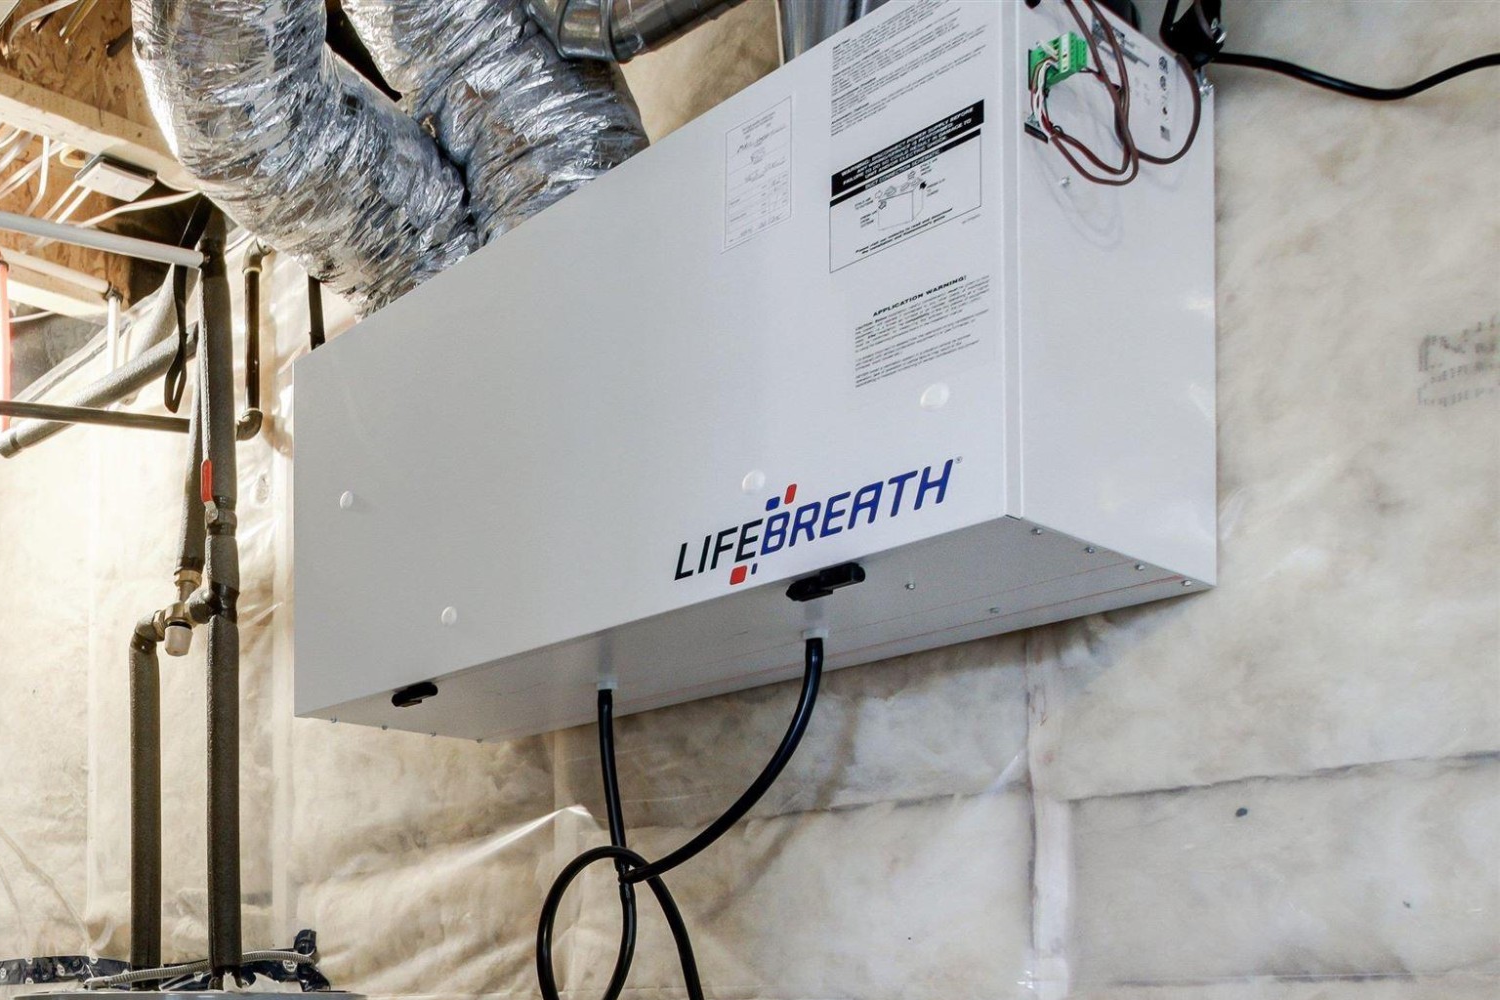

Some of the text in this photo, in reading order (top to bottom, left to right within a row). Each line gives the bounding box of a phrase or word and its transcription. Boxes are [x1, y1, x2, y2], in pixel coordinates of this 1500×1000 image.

[906, 130, 925, 143] POWER
[927, 118, 948, 133] SUPPLY
[949, 106, 973, 122] BEFORE
[864, 179, 877, 189] DUCT
[879, 163, 910, 183] CONNECTION
[872, 275, 967, 317] APPLICATION WARNING!
[674, 458, 953, 581] LIFEBREATH
